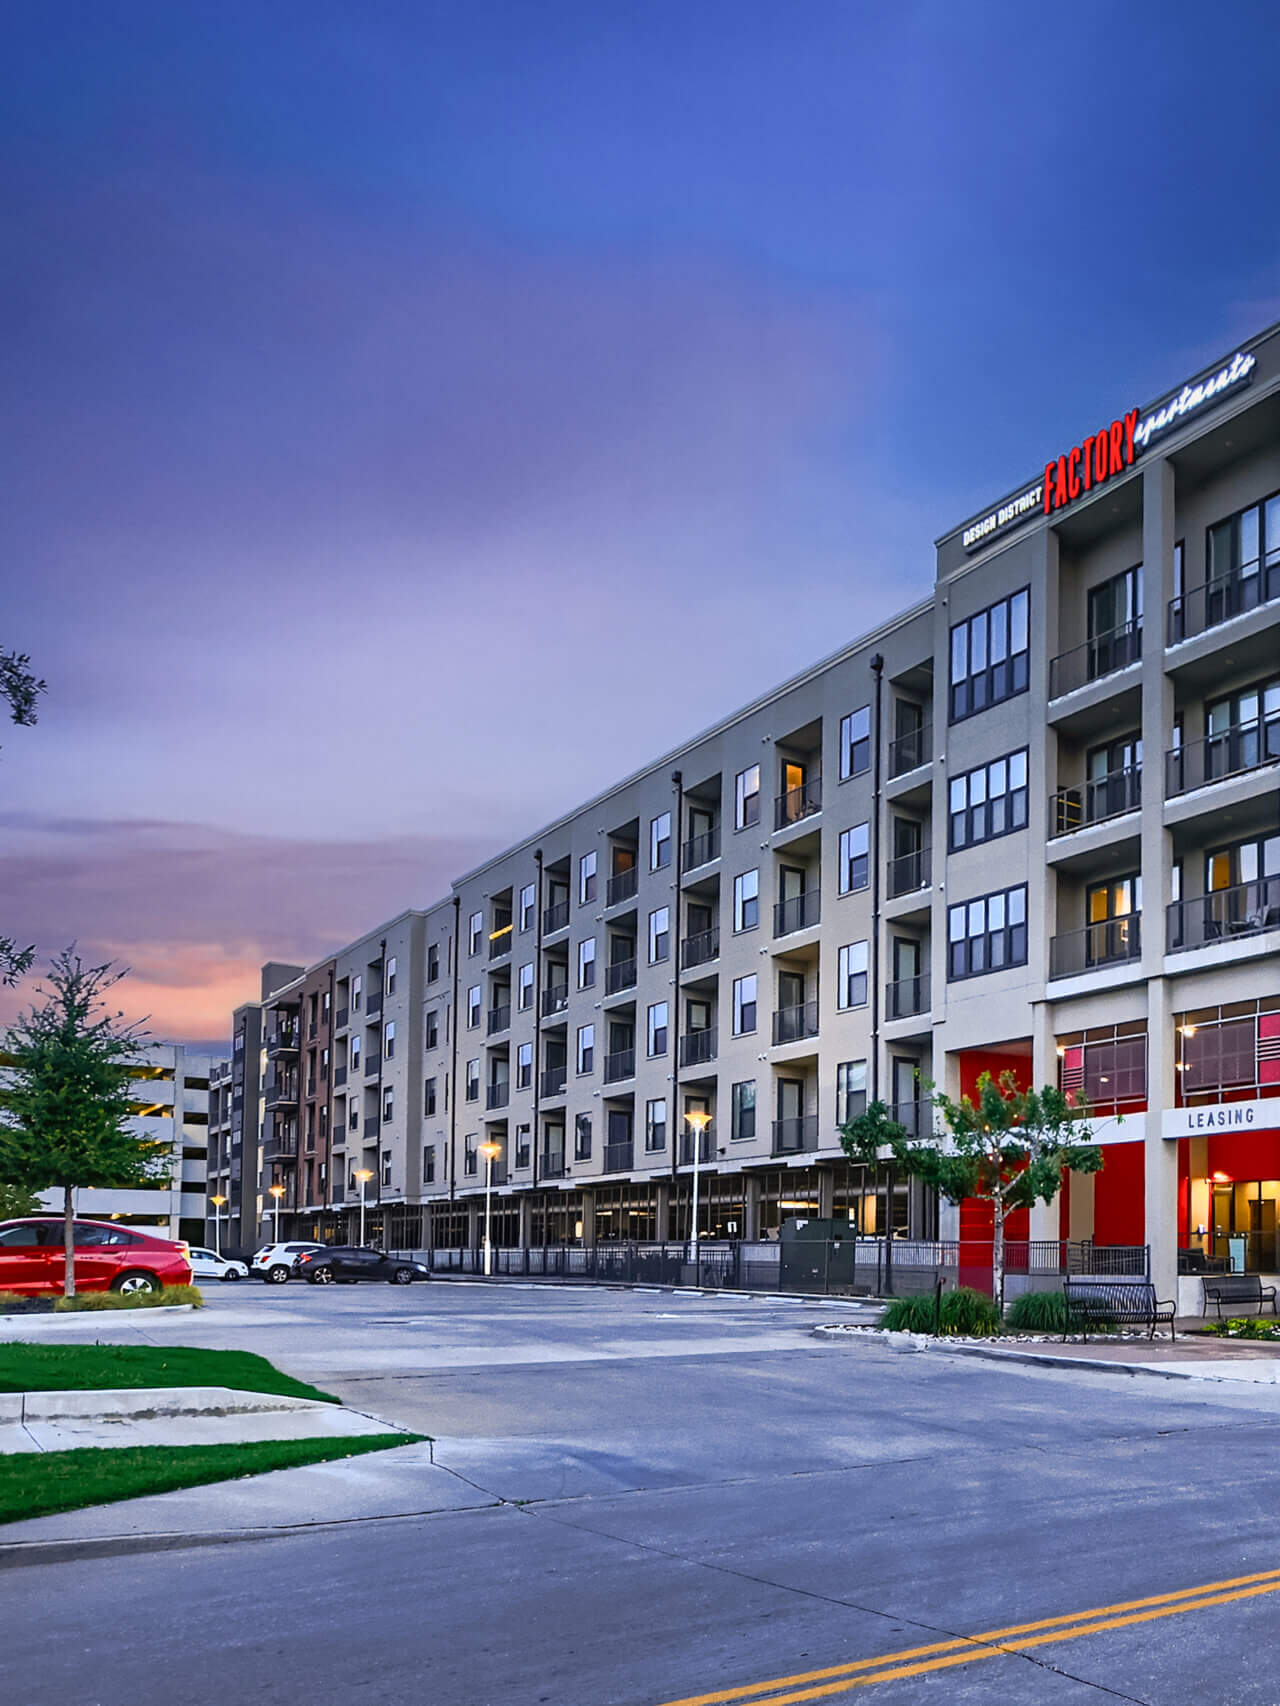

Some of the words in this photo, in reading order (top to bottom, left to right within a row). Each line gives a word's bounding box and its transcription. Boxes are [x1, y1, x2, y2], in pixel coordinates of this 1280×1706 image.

[963, 516, 996, 546] DESIGN
[998, 487, 1042, 525] DISTRICT
[1044, 408, 1139, 514] FACTORY
[1188, 1108, 1254, 1129] LEASING
